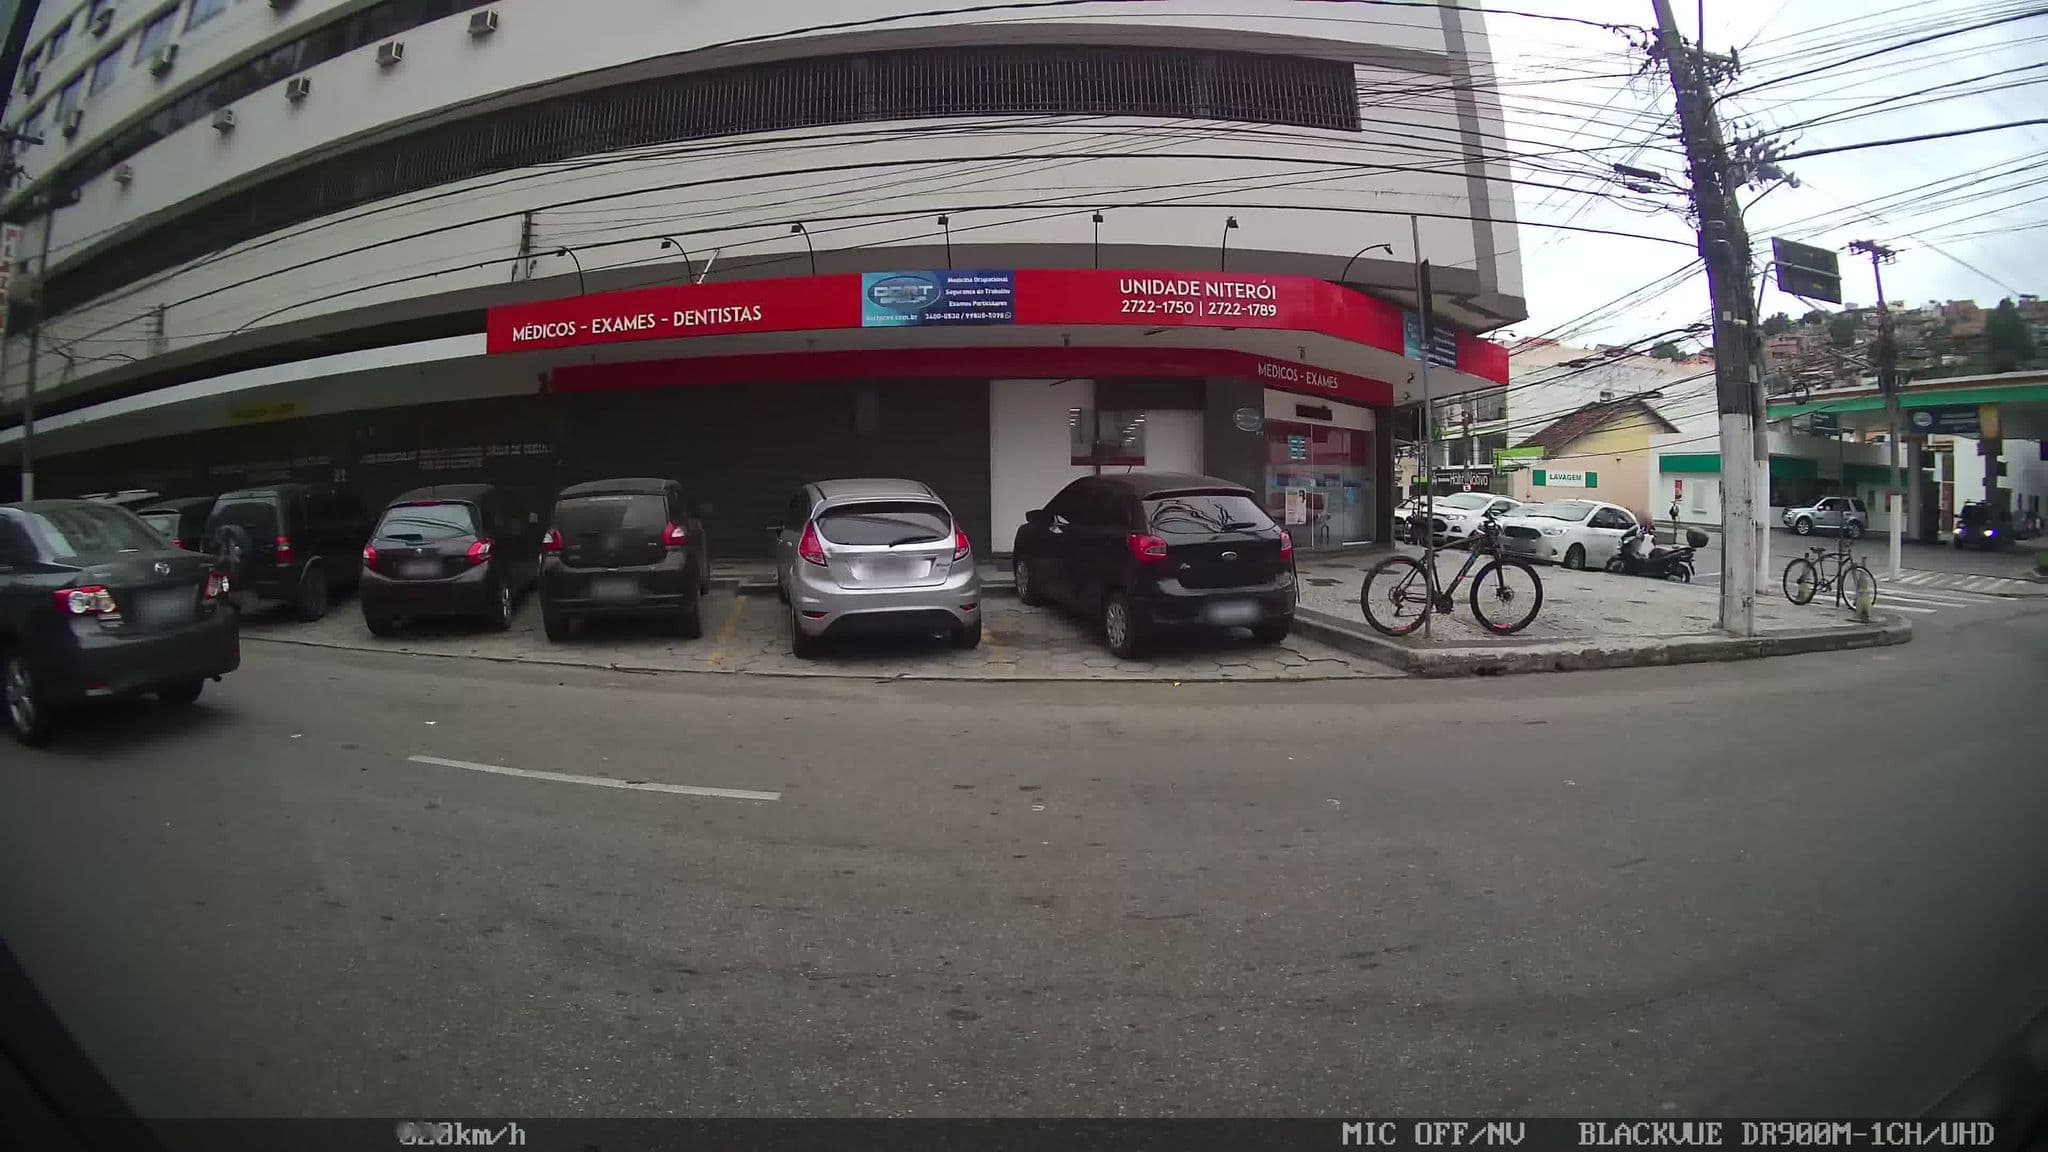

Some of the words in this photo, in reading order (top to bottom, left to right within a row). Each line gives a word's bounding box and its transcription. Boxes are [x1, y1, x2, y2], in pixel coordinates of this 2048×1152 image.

[1119, 278, 1200, 296] UNIDADE
[1205, 279, 1276, 300] NITERÓI
[1120, 299, 1194, 314] 2722-1750
[1207, 302, 1277, 317] 2722-1789
[512, 321, 576, 343] MÉDICOS
[591, 313, 656, 335] EXAMES
[673, 305, 762, 327] DENTISTAS
[1306, 371, 1339, 389] EXAMES
[1549, 473, 1582, 481] LAVAGEM
